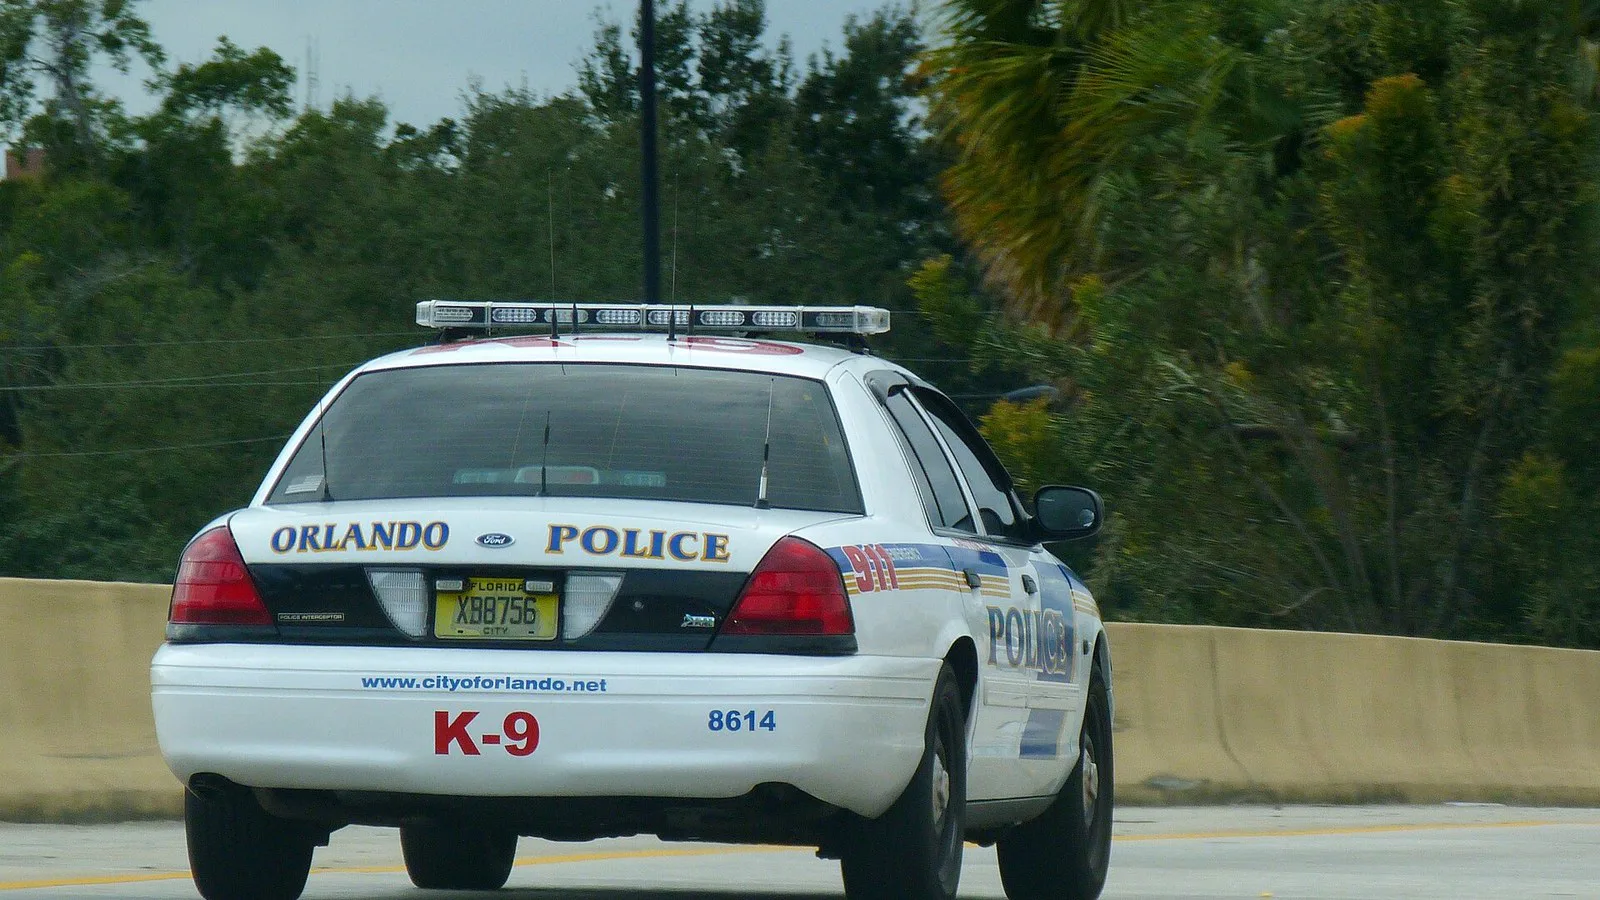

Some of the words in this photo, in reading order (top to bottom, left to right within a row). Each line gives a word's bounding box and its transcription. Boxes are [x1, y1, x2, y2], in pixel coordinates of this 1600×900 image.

[270, 521, 450, 554] ORLANDO
[545, 524, 731, 562] POLICE
[842, 543, 899, 593] 911
[470, 582, 524, 592] FLORIDA
[482, 627, 508, 635] CITY
[986, 605, 1067, 675] POLICE
[361, 675, 607, 692] www.cityoforlando.net
[434, 710, 541, 756] K-9
[707, 710, 777, 732] 8614
